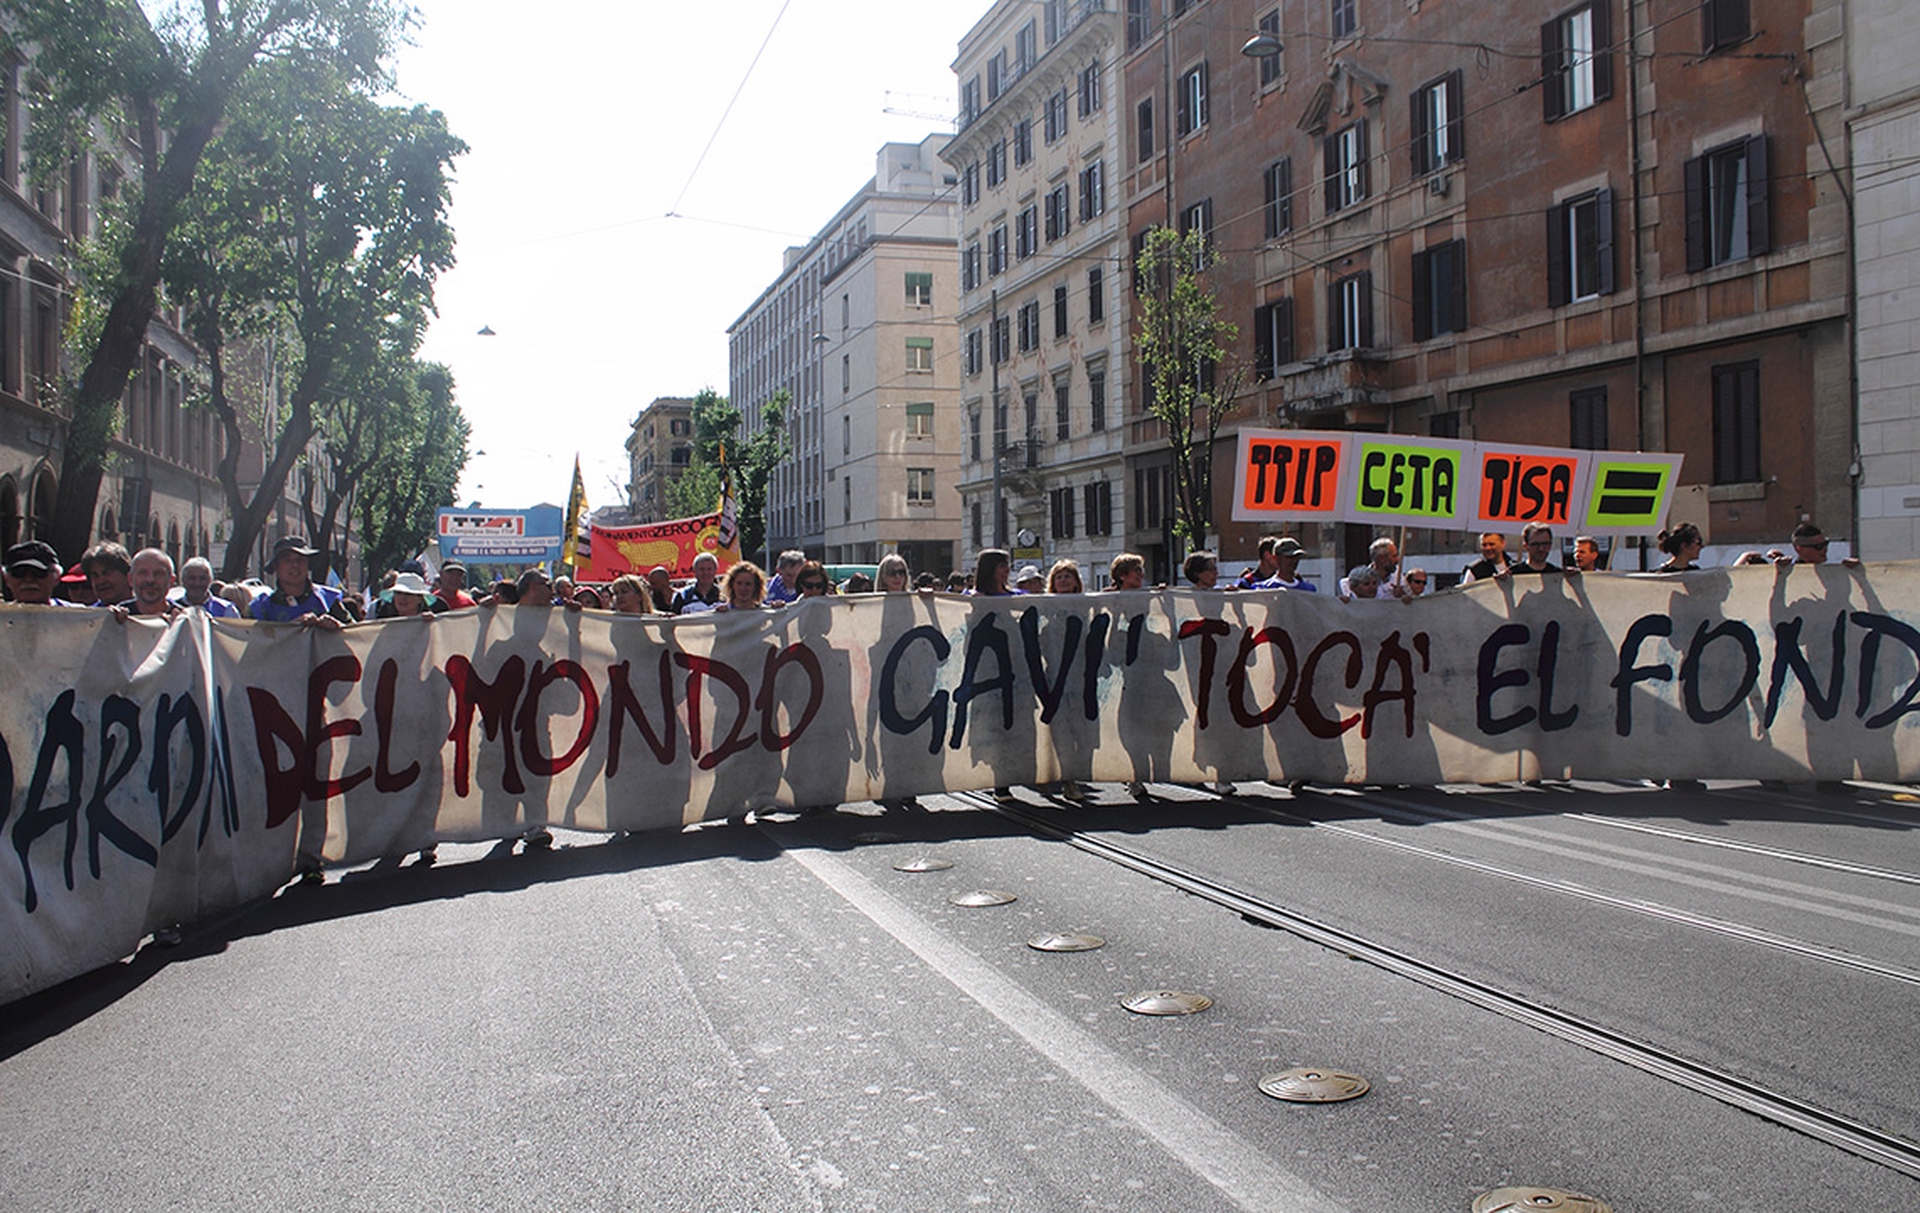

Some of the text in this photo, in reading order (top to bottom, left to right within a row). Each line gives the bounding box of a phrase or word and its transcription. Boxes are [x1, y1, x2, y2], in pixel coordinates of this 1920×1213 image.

[1251, 444, 1336, 507] TTIP
[1361, 451, 1454, 515] CETA
[246, 655, 420, 830] DEL
[445, 642, 825, 798] MONDO
[1476, 620, 1579, 736] EL
